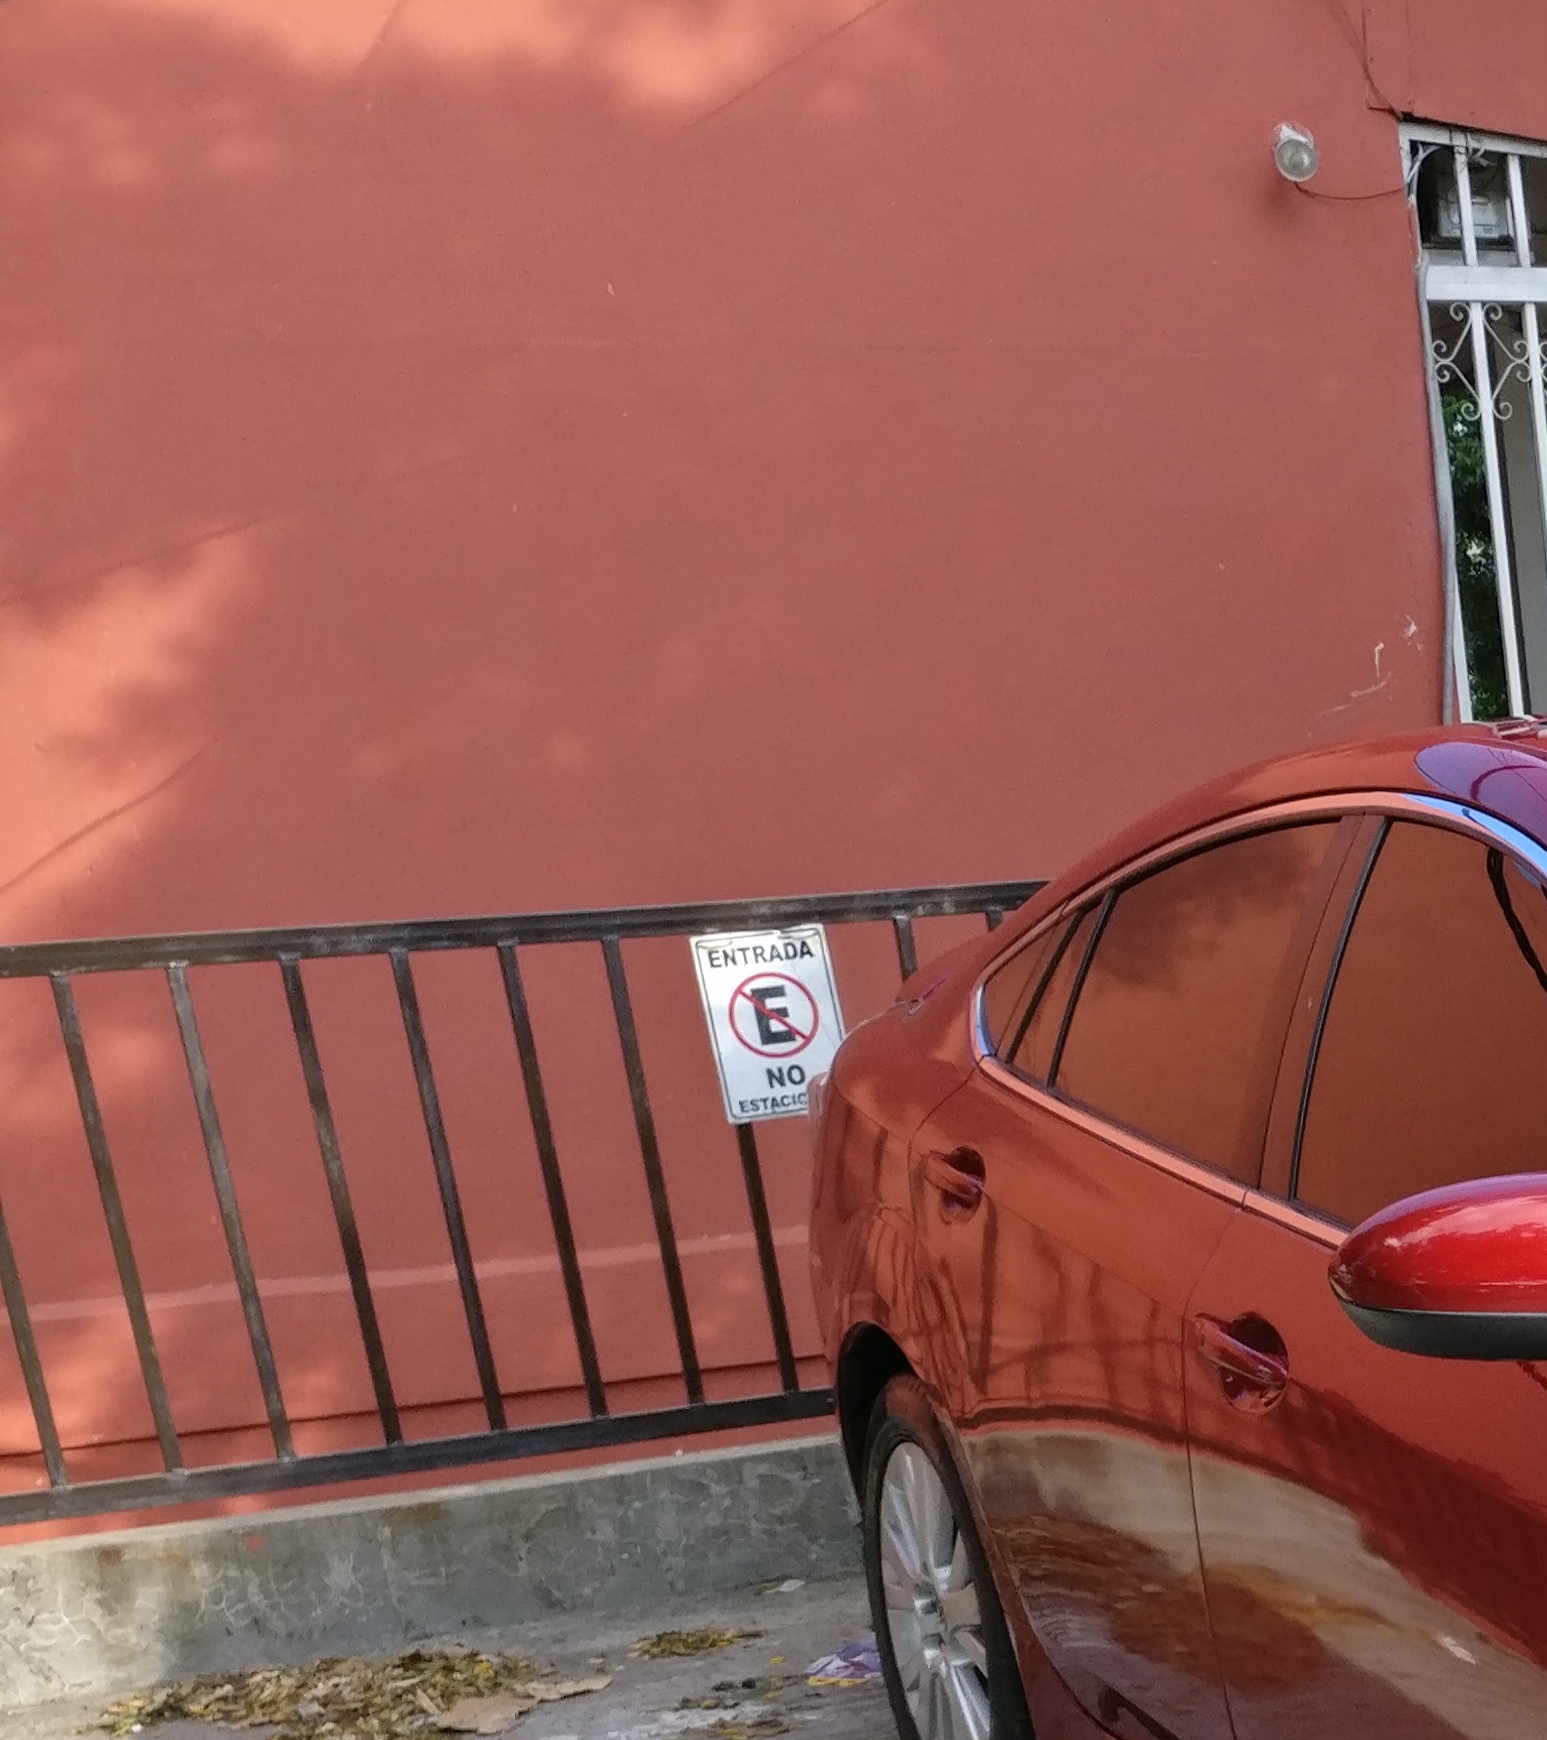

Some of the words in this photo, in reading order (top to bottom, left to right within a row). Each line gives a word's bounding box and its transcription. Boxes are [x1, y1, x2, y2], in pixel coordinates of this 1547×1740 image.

[707, 940, 814, 968] ENTRADA
[750, 985, 796, 1046] E
[766, 1064, 805, 1089] NO
[738, 1092, 808, 1114] ESTACIO
